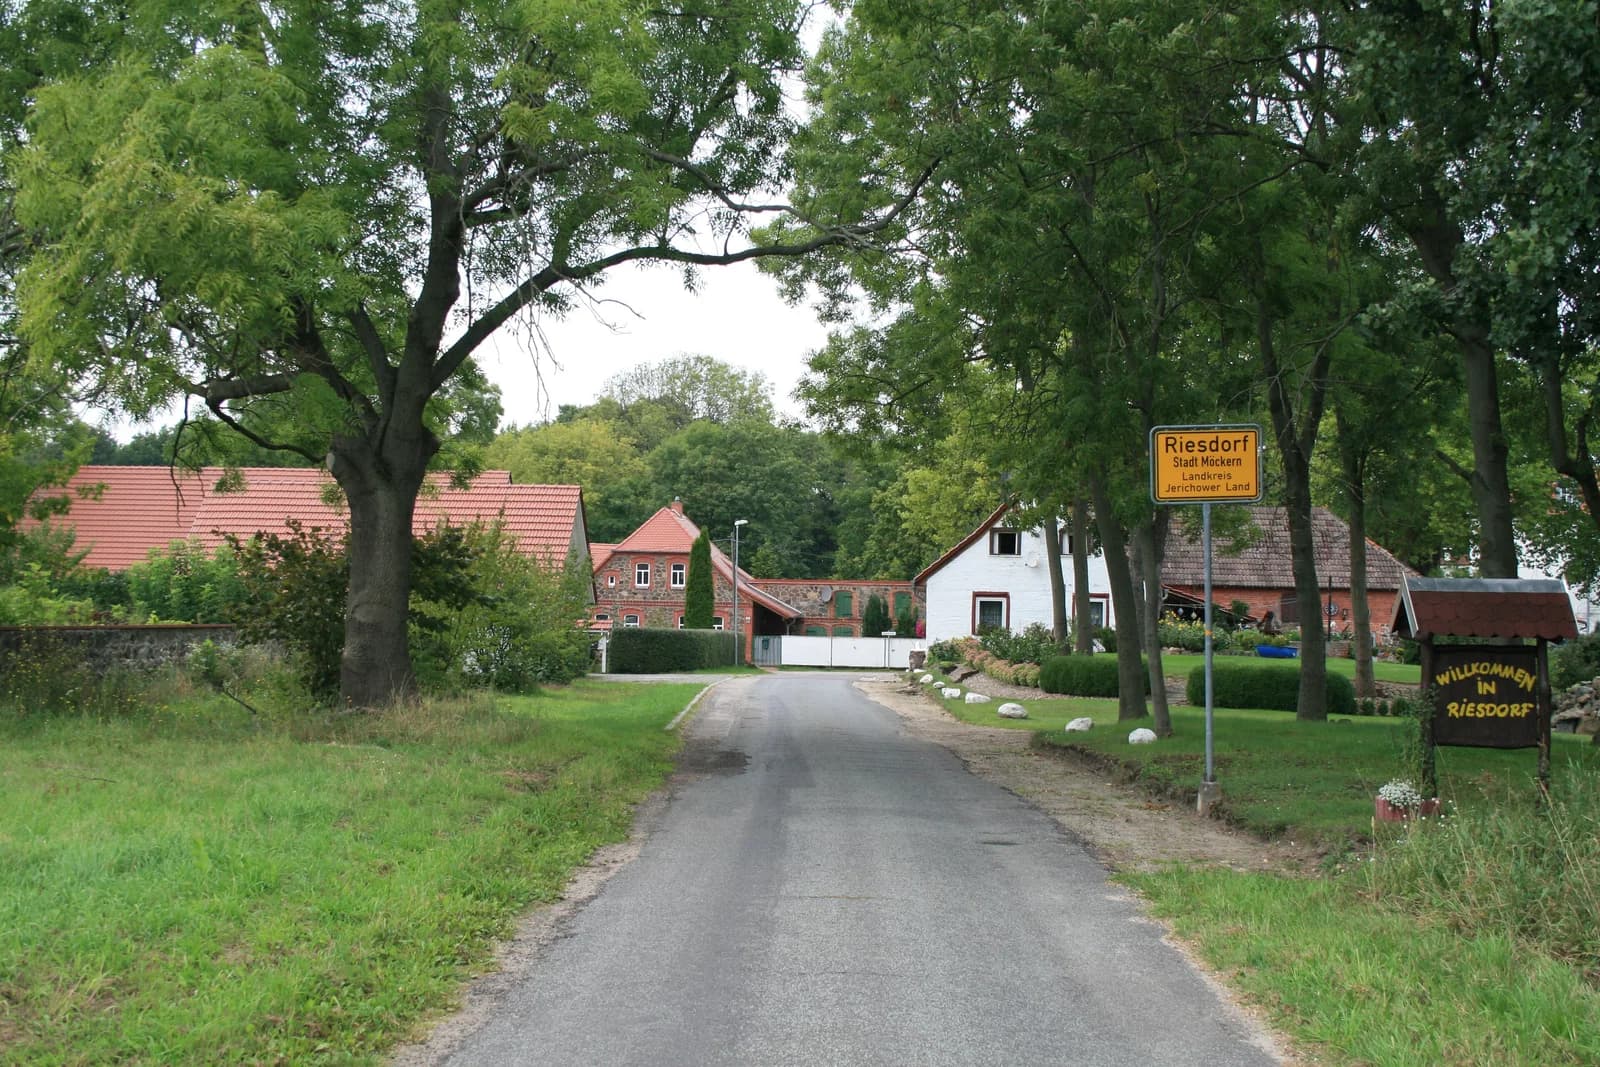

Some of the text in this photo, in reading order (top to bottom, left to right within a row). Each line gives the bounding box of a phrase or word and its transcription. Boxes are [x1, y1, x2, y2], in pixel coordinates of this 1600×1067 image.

[1165, 435, 1249, 453] Riesdorf
[1173, 456, 1242, 468] Stadt Möckern
[1182, 471, 1232, 481] Landkreis
[1165, 482, 1250, 493] Jerichower Land
